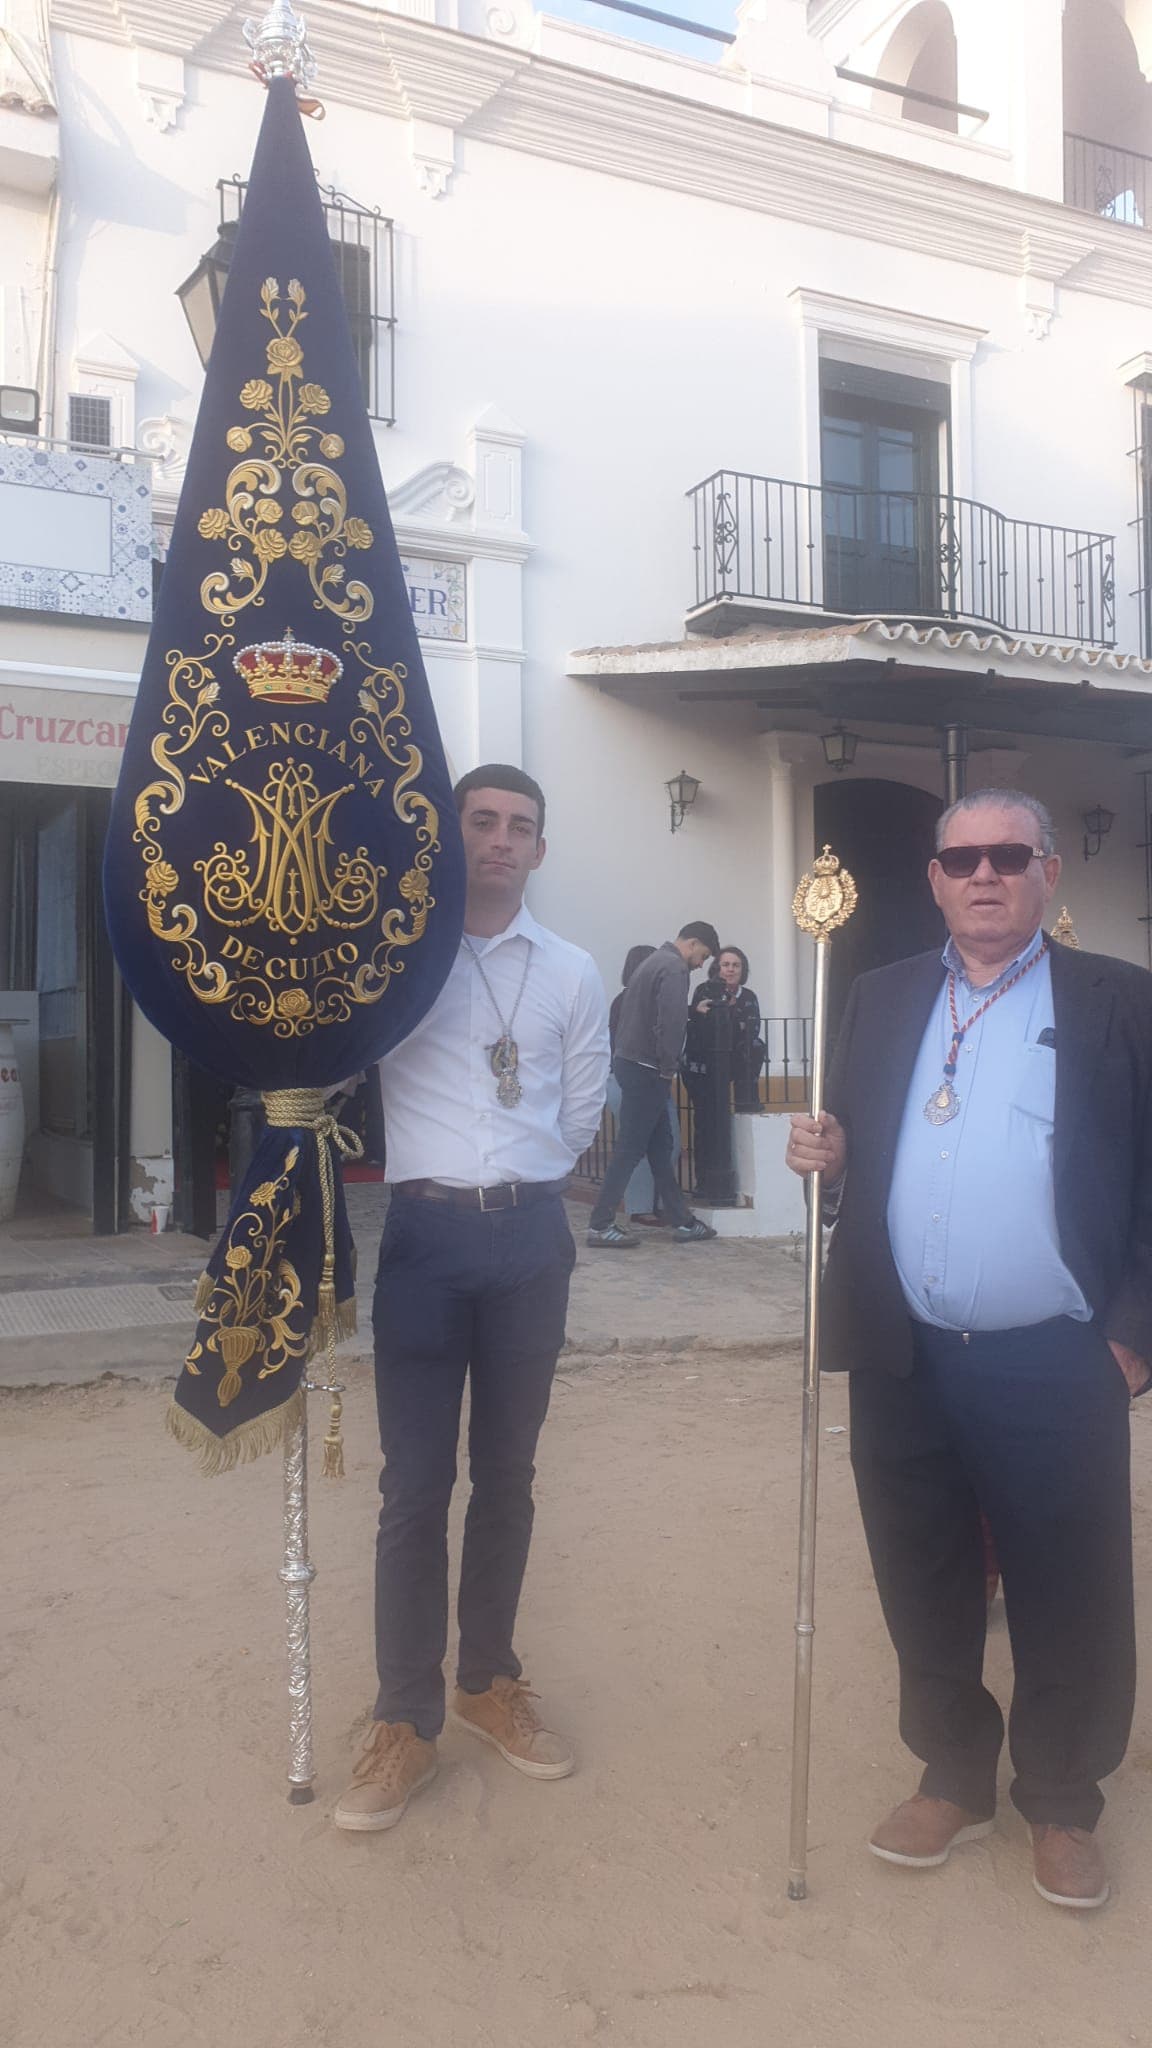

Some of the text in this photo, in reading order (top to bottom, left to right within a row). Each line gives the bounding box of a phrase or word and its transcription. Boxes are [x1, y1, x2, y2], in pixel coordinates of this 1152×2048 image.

[408, 586, 448, 617] ER
[188, 721, 385, 798] VALENCIANA
[219, 934, 359, 980] DE CULTO
